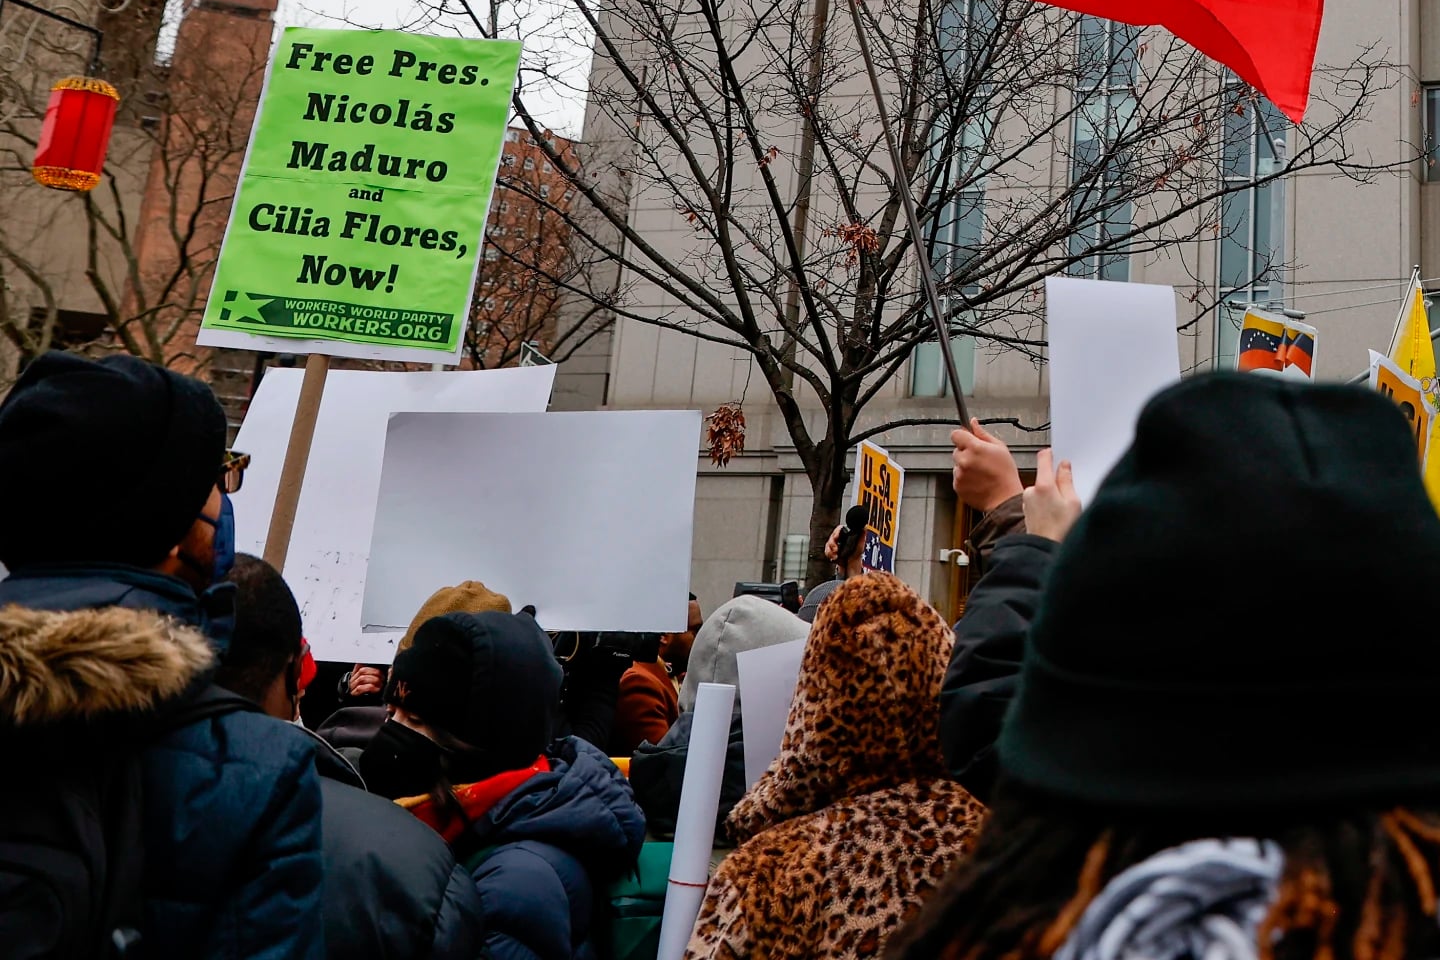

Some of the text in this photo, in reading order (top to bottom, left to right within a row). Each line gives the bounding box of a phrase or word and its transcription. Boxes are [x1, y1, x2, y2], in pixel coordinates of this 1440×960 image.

[285, 42, 490, 86] Free Pres.
[303, 92, 456, 134] Nicolás
[286, 140, 448, 182] Maduro
[348, 188, 385, 203] and
[248, 203, 468, 259] Cilia Flores,
[296, 254, 399, 293] Now!
[285, 299, 446, 325] WORKERS WORLD PARTY
[293, 312, 442, 340] WORKERS.ORG
